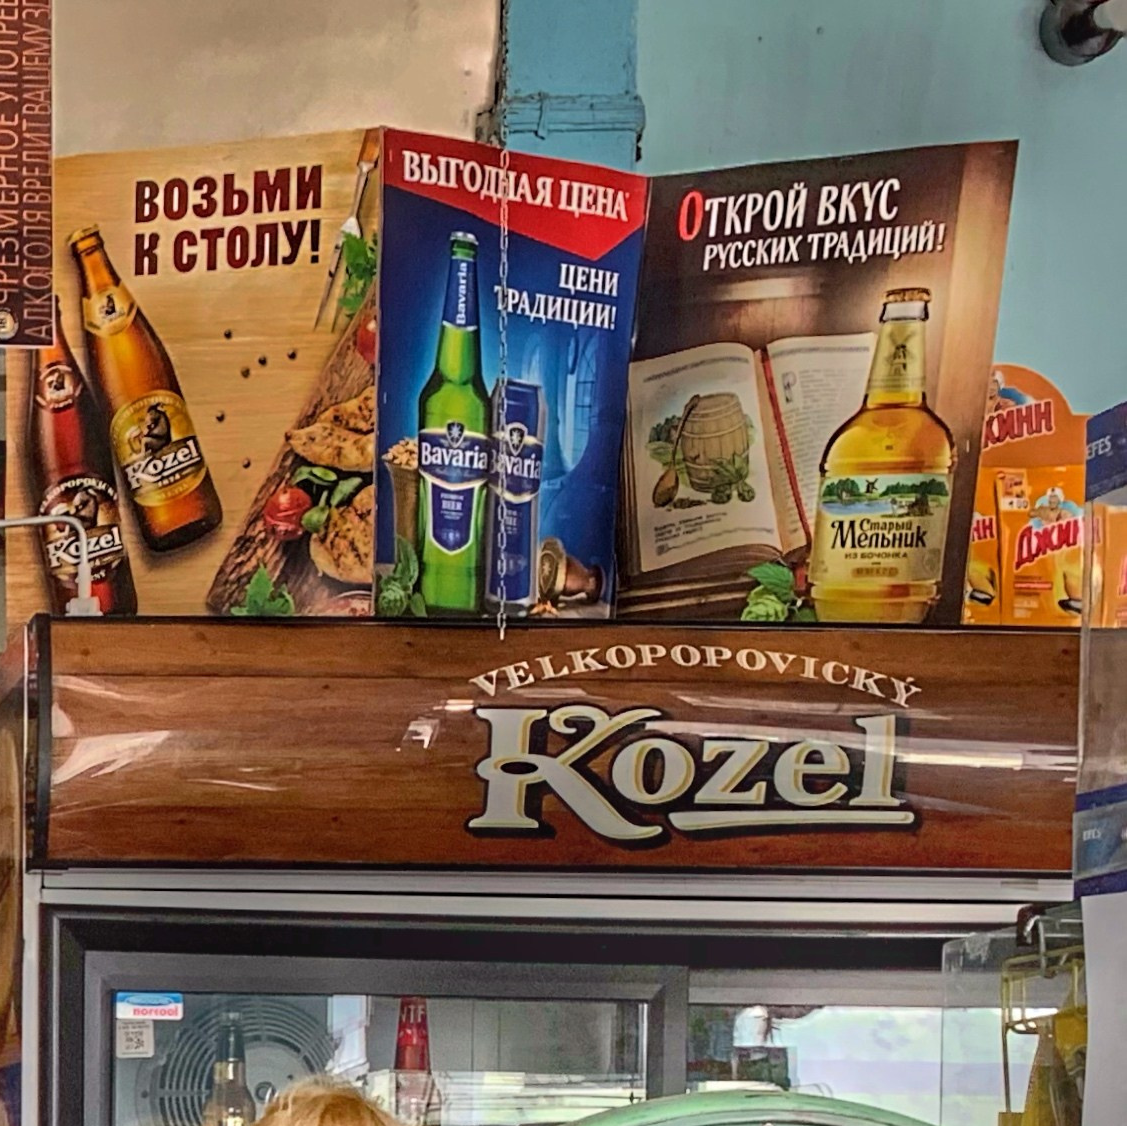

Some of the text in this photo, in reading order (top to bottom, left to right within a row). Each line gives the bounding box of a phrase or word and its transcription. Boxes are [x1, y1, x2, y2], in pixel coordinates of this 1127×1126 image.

[23, 115, 51, 203] ВРЕДИТ
[402, 150, 553, 207] ВЫГОДНАЯ
[135, 165, 323, 223] ВОЗЬМИ
[679, 178, 901, 241] ОТКРОЙ ВКУС
[134, 220, 320, 275] К СТОЛУ!
[703, 220, 946, 271] РУССКИХ ТРАДИЦИЙ!
[23, 210, 52, 340] АЛКОГОЛЯ
[455, 261, 468, 326] Bavaria
[559, 263, 619, 297] ЦЕНИ
[494, 284, 617, 331] ТРАДИЦИИ!
[125, 439, 202, 491] Kozel
[421, 441, 489, 471] Bavaria
[831, 520, 928, 551] Мельник
[859, 518, 913, 535] Старый
[467, 642, 921, 708] VELKOPOPOVICKÝ
[468, 705, 917, 842] Kozel
[132, 1006, 180, 1018] norcool
